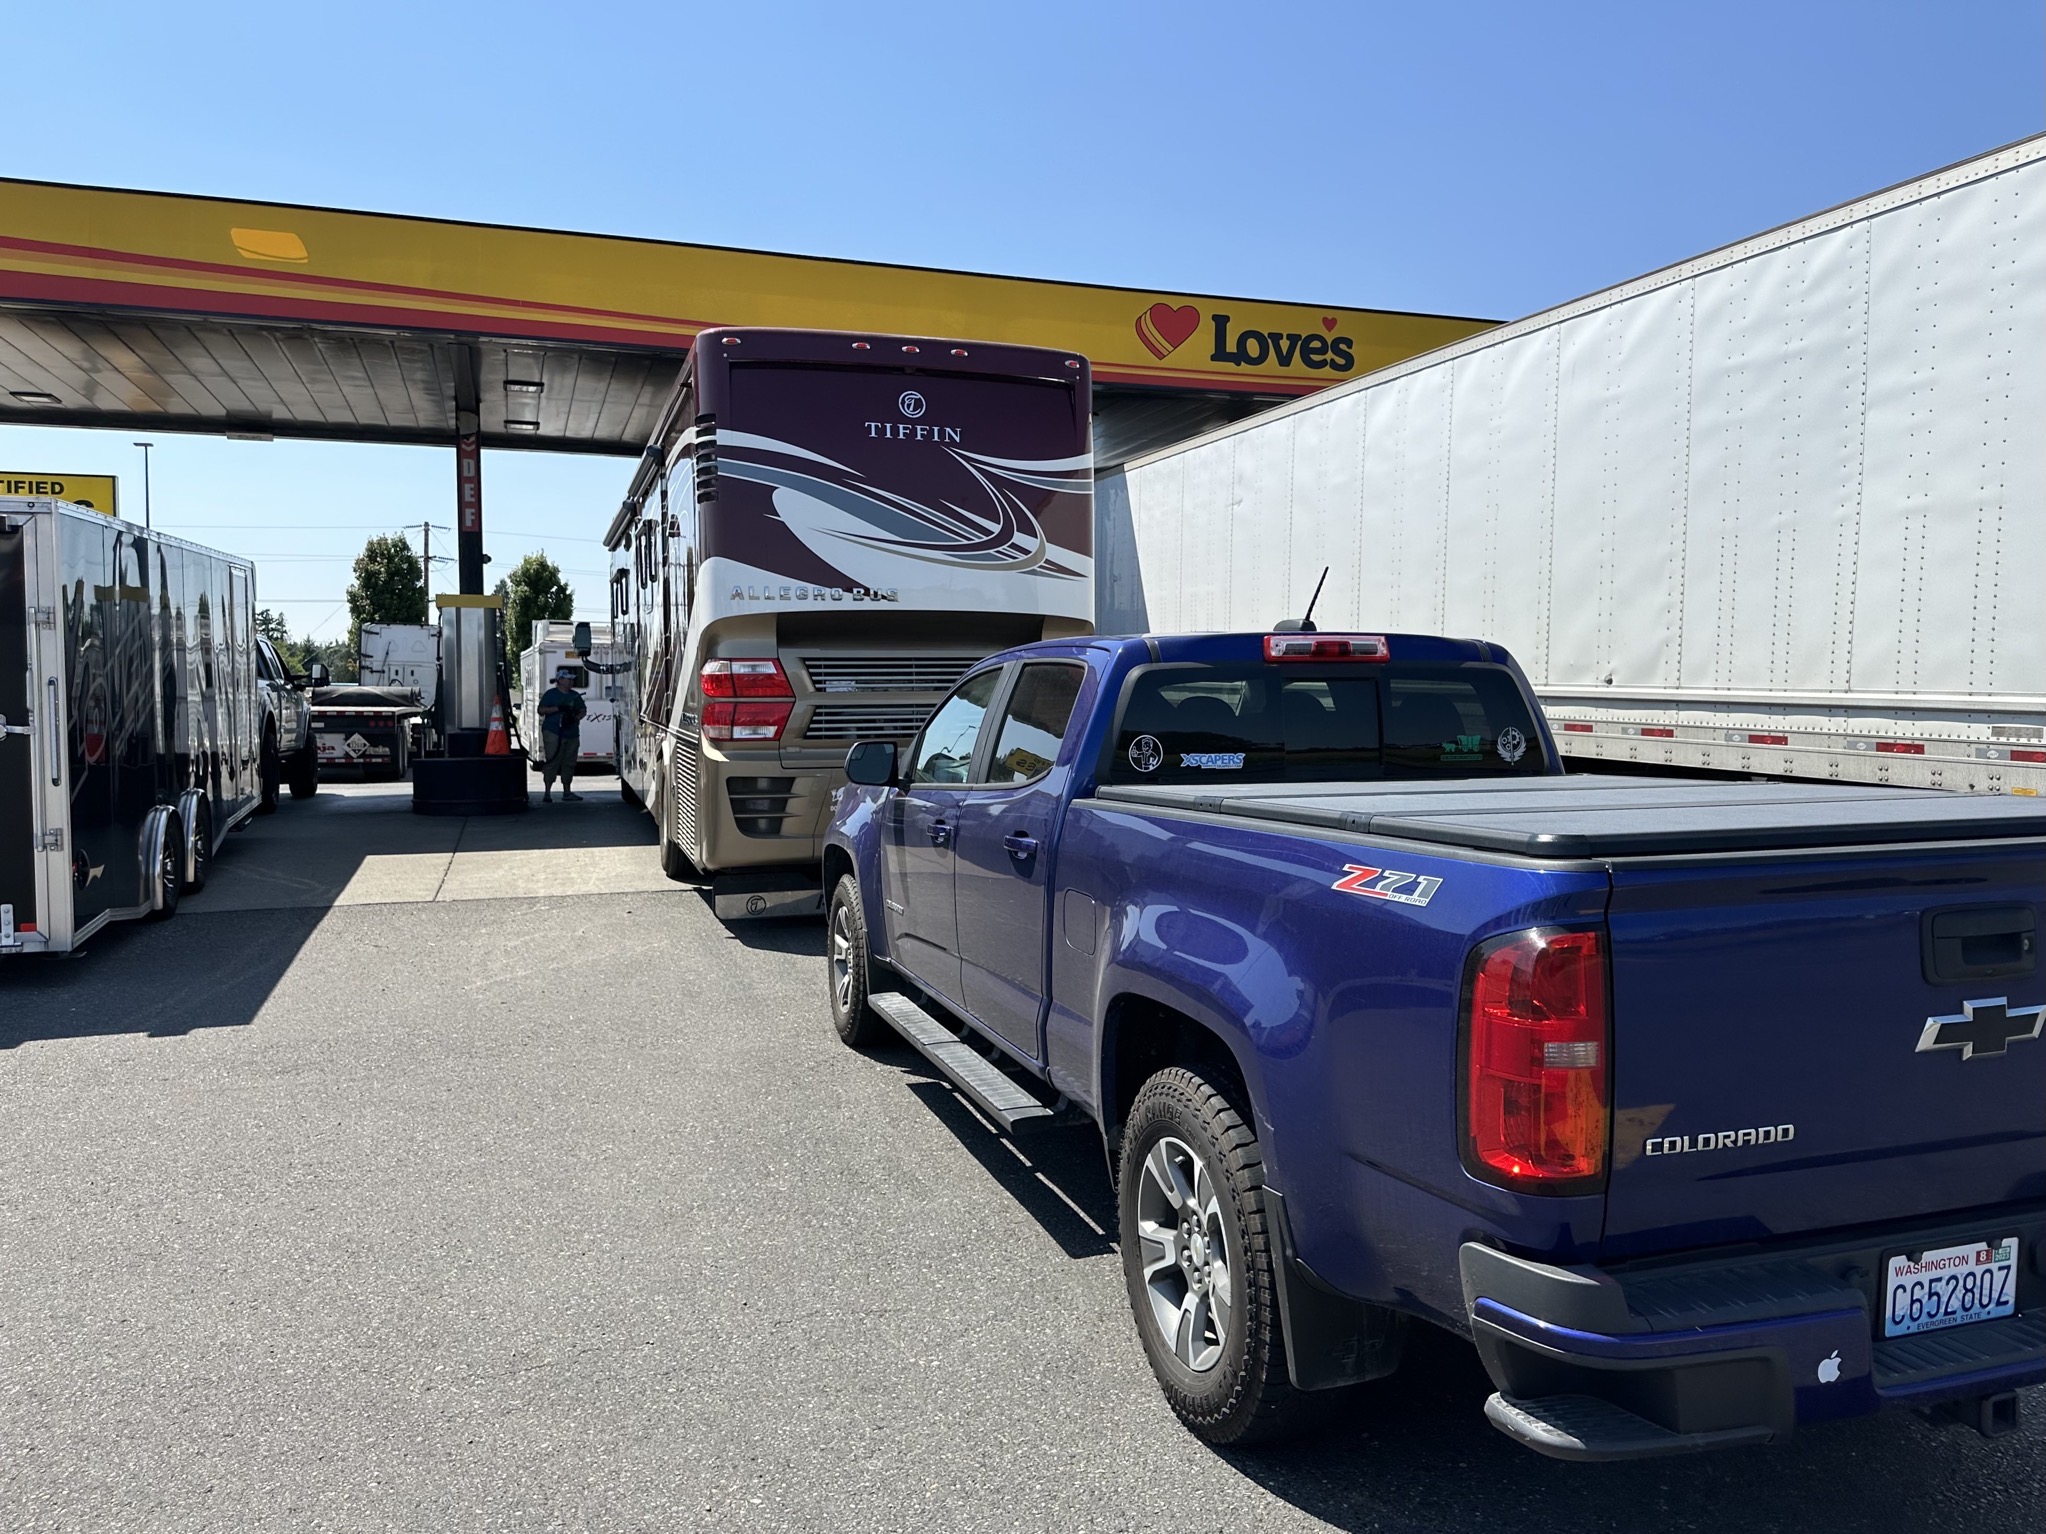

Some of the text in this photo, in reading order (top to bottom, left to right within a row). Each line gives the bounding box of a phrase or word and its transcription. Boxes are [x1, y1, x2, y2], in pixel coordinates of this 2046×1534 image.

[865, 421, 961, 443] TIFFIN
[0, 480, 65, 495] IFIED
[463, 458, 476, 527] DEF
[730, 585, 899, 602] ALLEGRO BUS
[1180, 753, 1245, 767] XSCAPERS
[1331, 864, 1443, 900] Z71
[1404, 897, 1427, 905] ROAD
[1646, 1124, 1795, 1156] COLORADO
[1895, 1254, 1969, 1277] WASHINGTON
[1980, 1250, 1987, 1261] 8
[1891, 1265, 2012, 1326] C65280Z
[1917, 1312, 1982, 1330] EVERGREEN STATE
